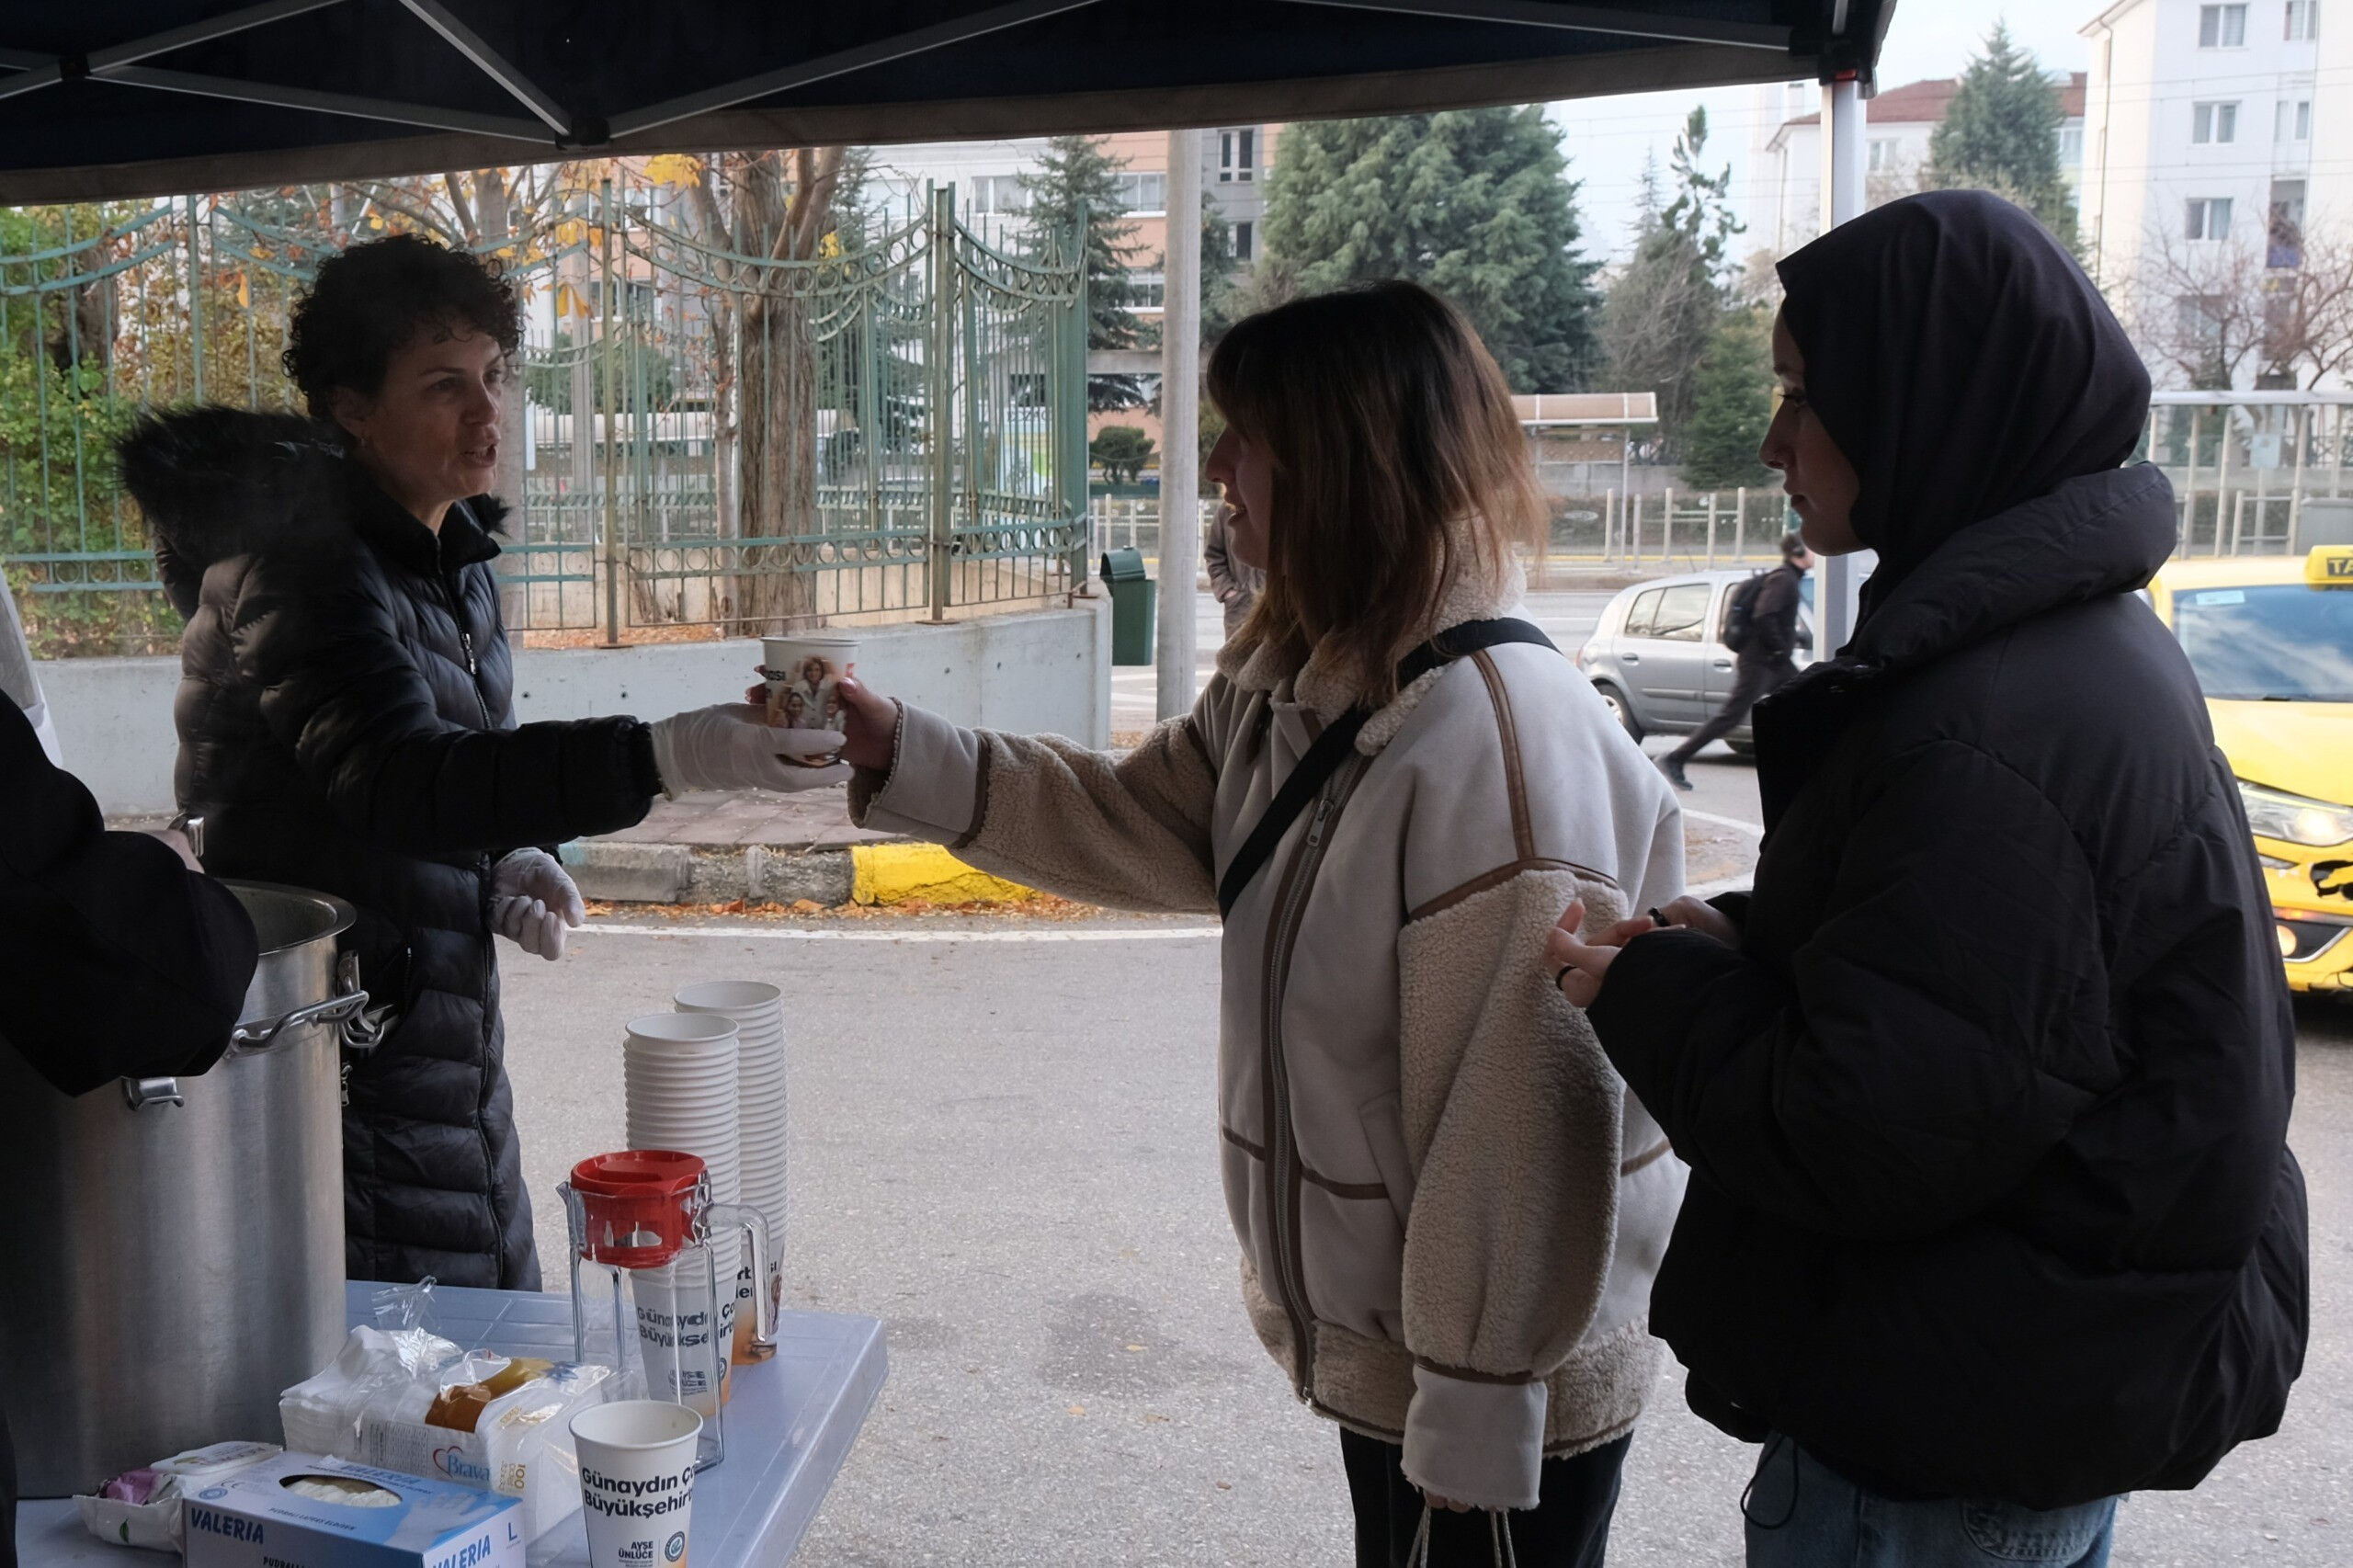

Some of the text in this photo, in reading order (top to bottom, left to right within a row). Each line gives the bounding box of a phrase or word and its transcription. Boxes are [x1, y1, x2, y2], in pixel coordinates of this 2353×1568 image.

[582, 1466, 678, 1497] Günaydın
[191, 1506, 265, 1545] VALERIA
[507, 1522, 517, 1541] L
